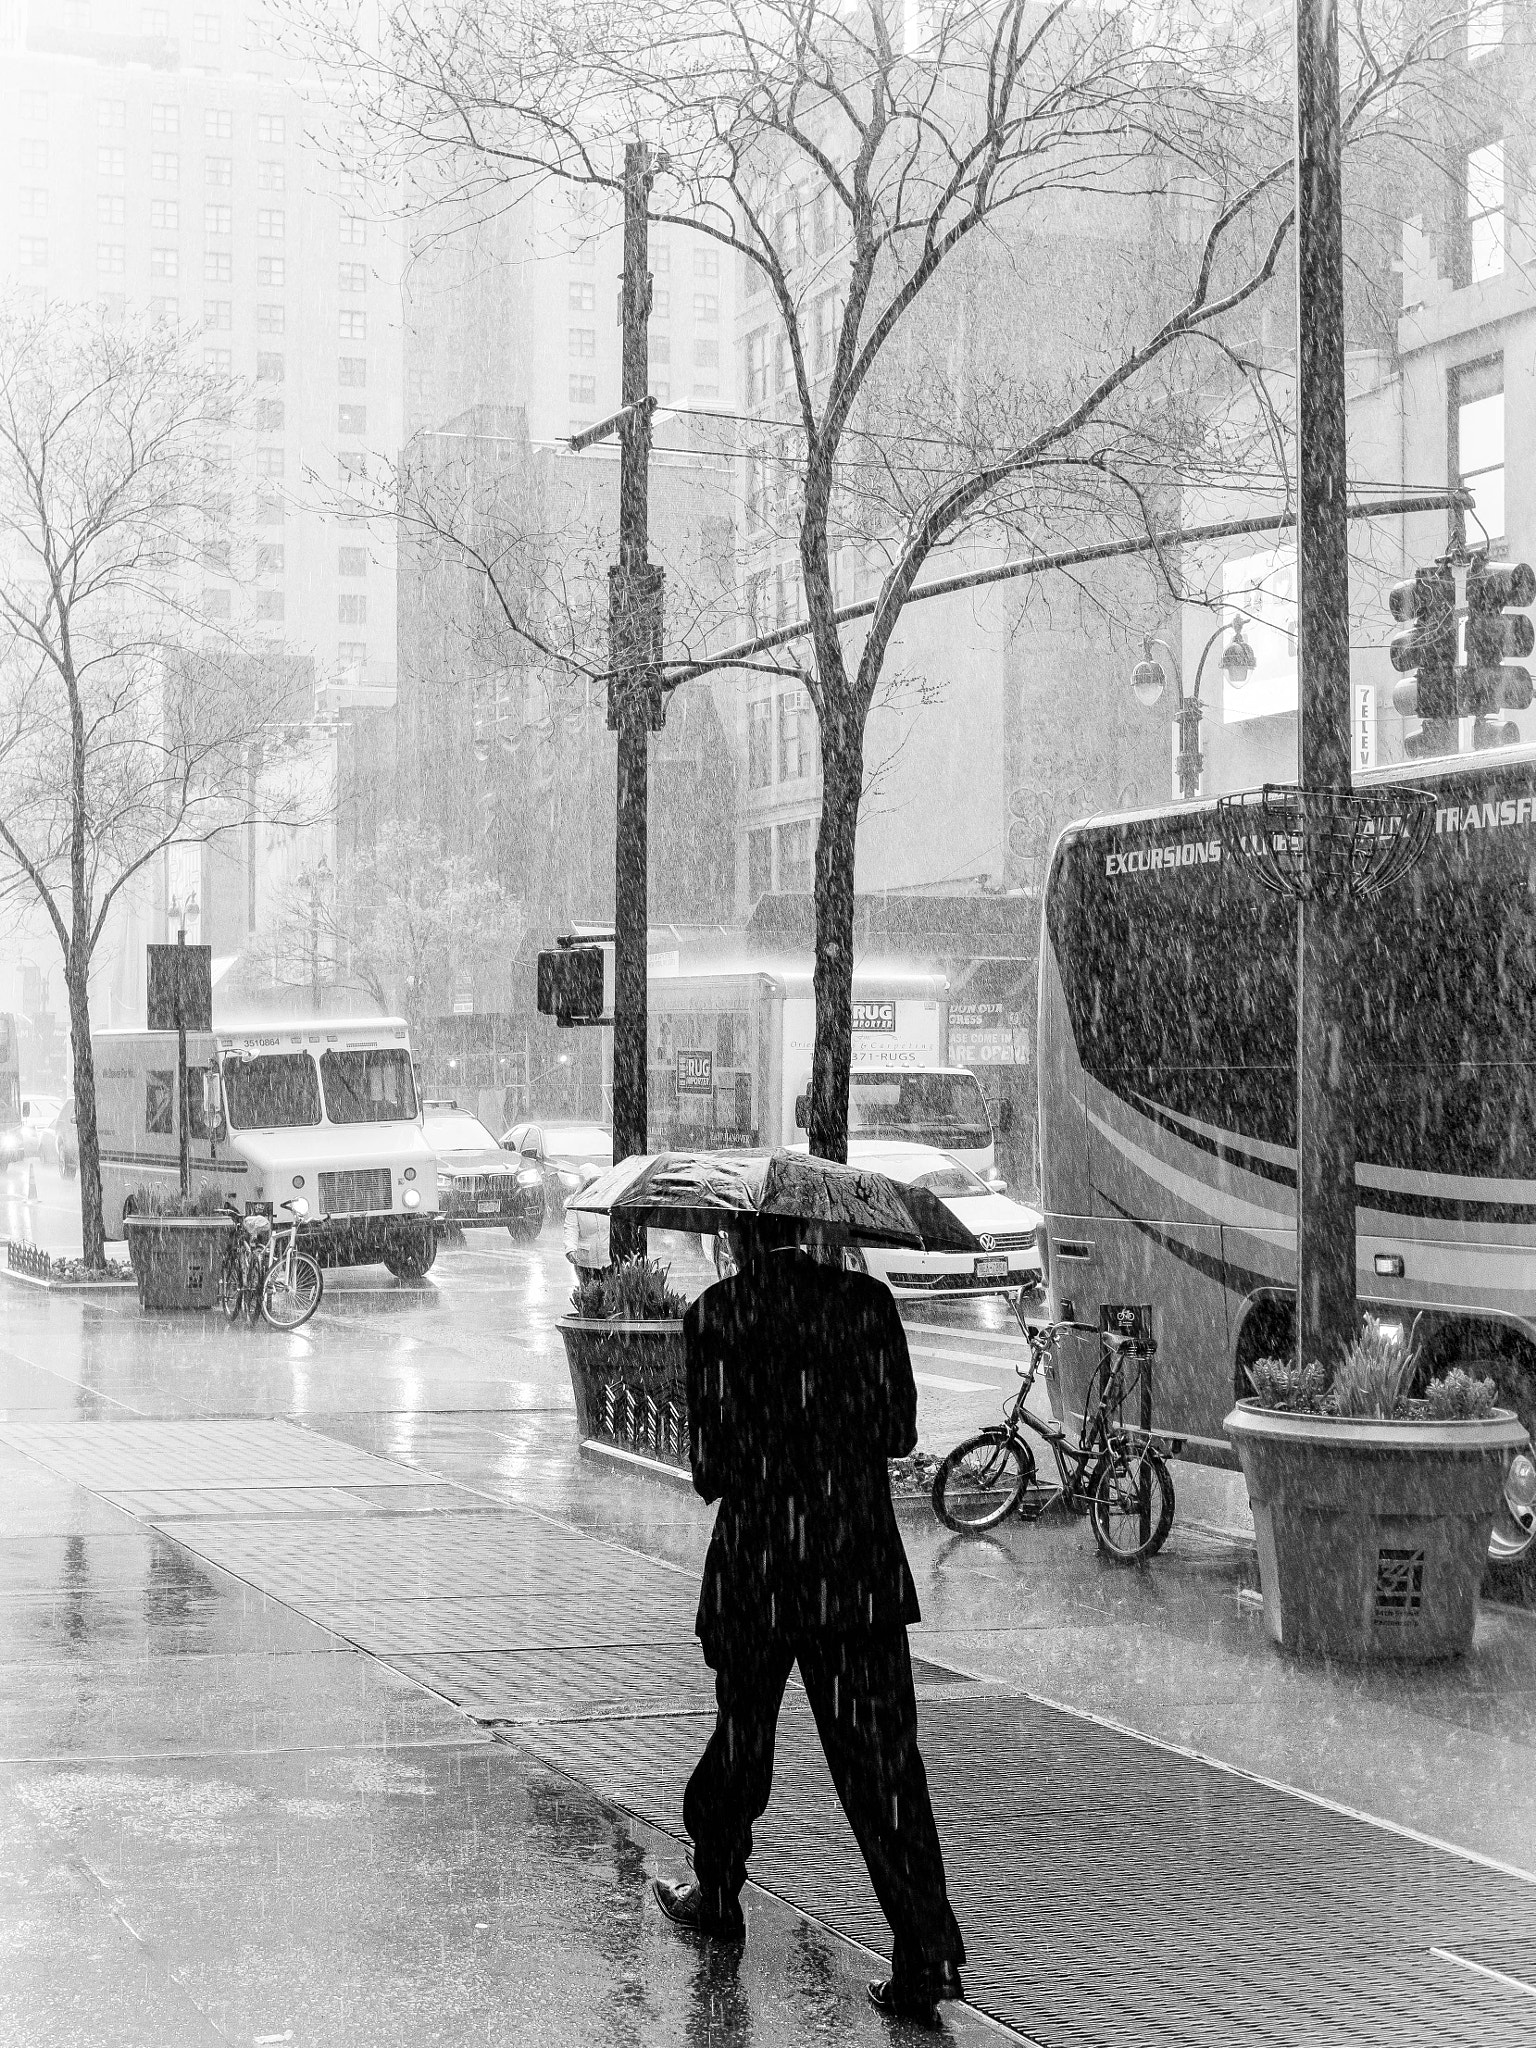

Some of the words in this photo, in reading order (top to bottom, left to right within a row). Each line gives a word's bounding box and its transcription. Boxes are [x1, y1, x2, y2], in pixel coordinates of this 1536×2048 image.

[1105, 840, 1221, 876] EXCURSIONS
[853, 1004, 893, 1020] RUG
[852, 1020, 893, 1029] MPORTER
[949, 1014, 983, 1025] GRESS
[243, 1038, 280, 1048] 3510864
[970, 1033, 998, 1043] COME
[688, 1058, 711, 1077] RUG
